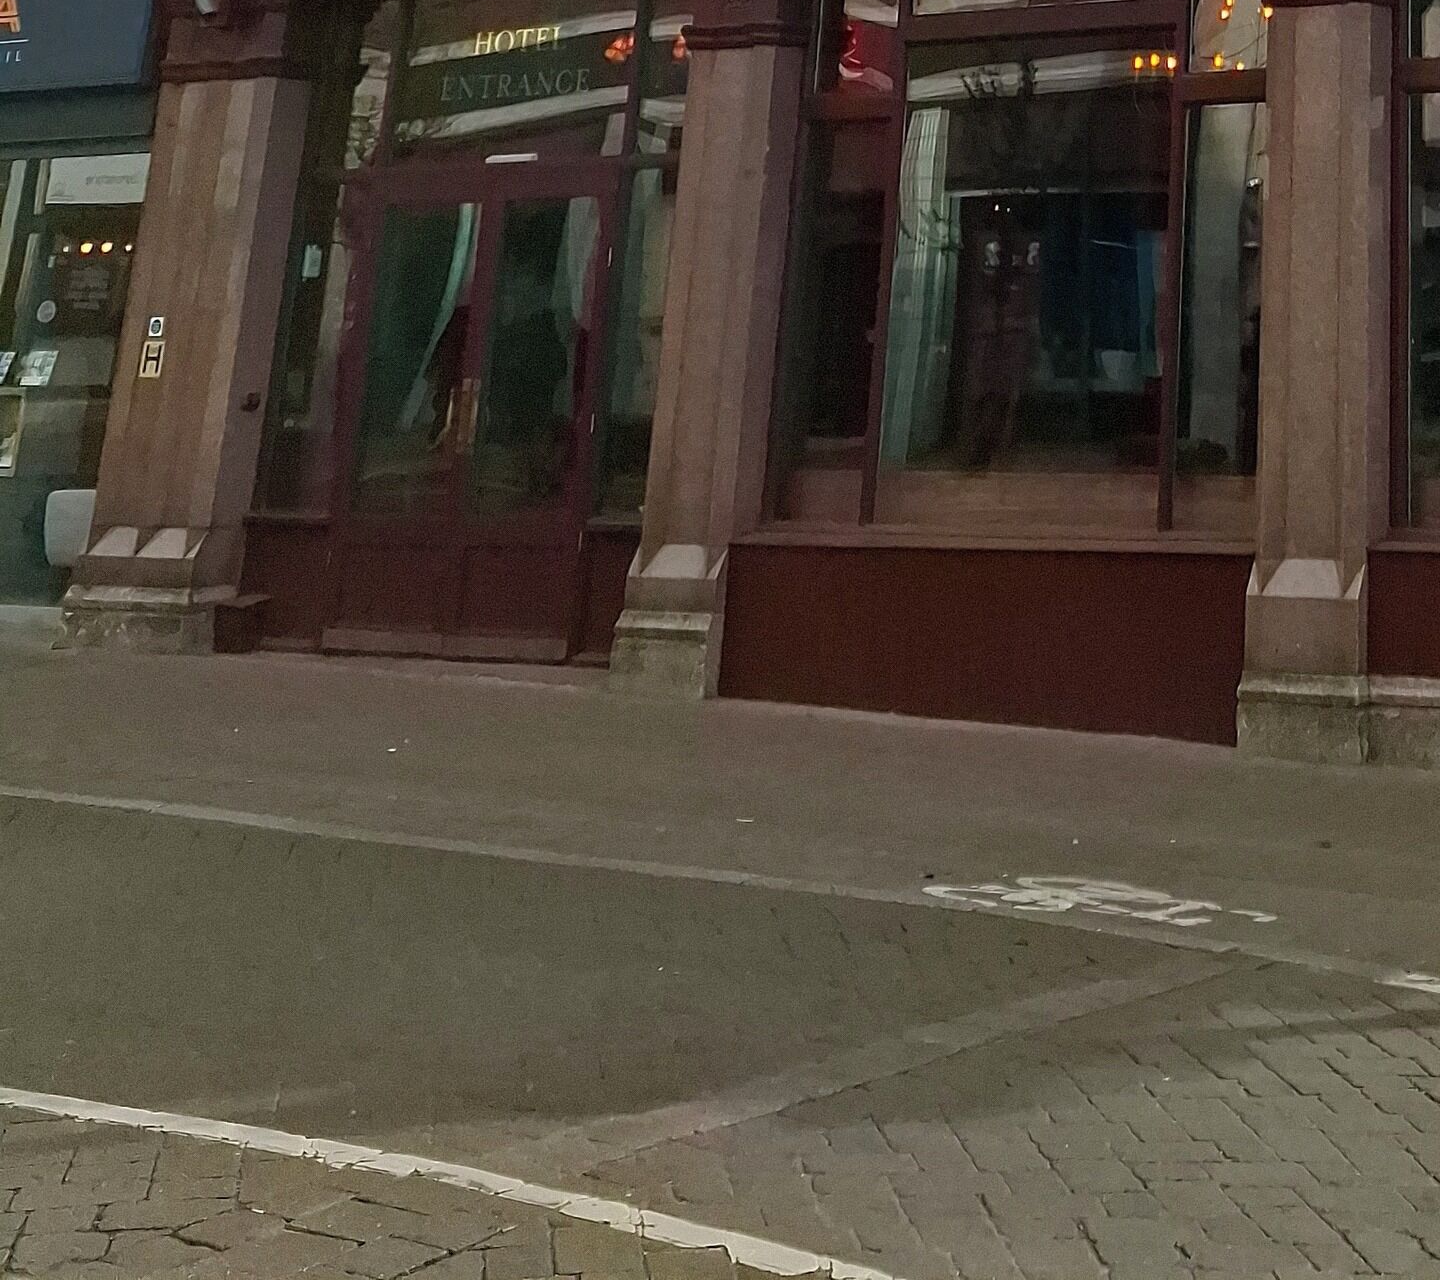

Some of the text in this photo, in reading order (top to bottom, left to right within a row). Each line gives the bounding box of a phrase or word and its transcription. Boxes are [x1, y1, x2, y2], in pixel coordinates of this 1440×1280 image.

[473, 25, 567, 55] HOTEL
[440, 68, 590, 101] ENTRANCE
[142, 343, 162, 375] H
